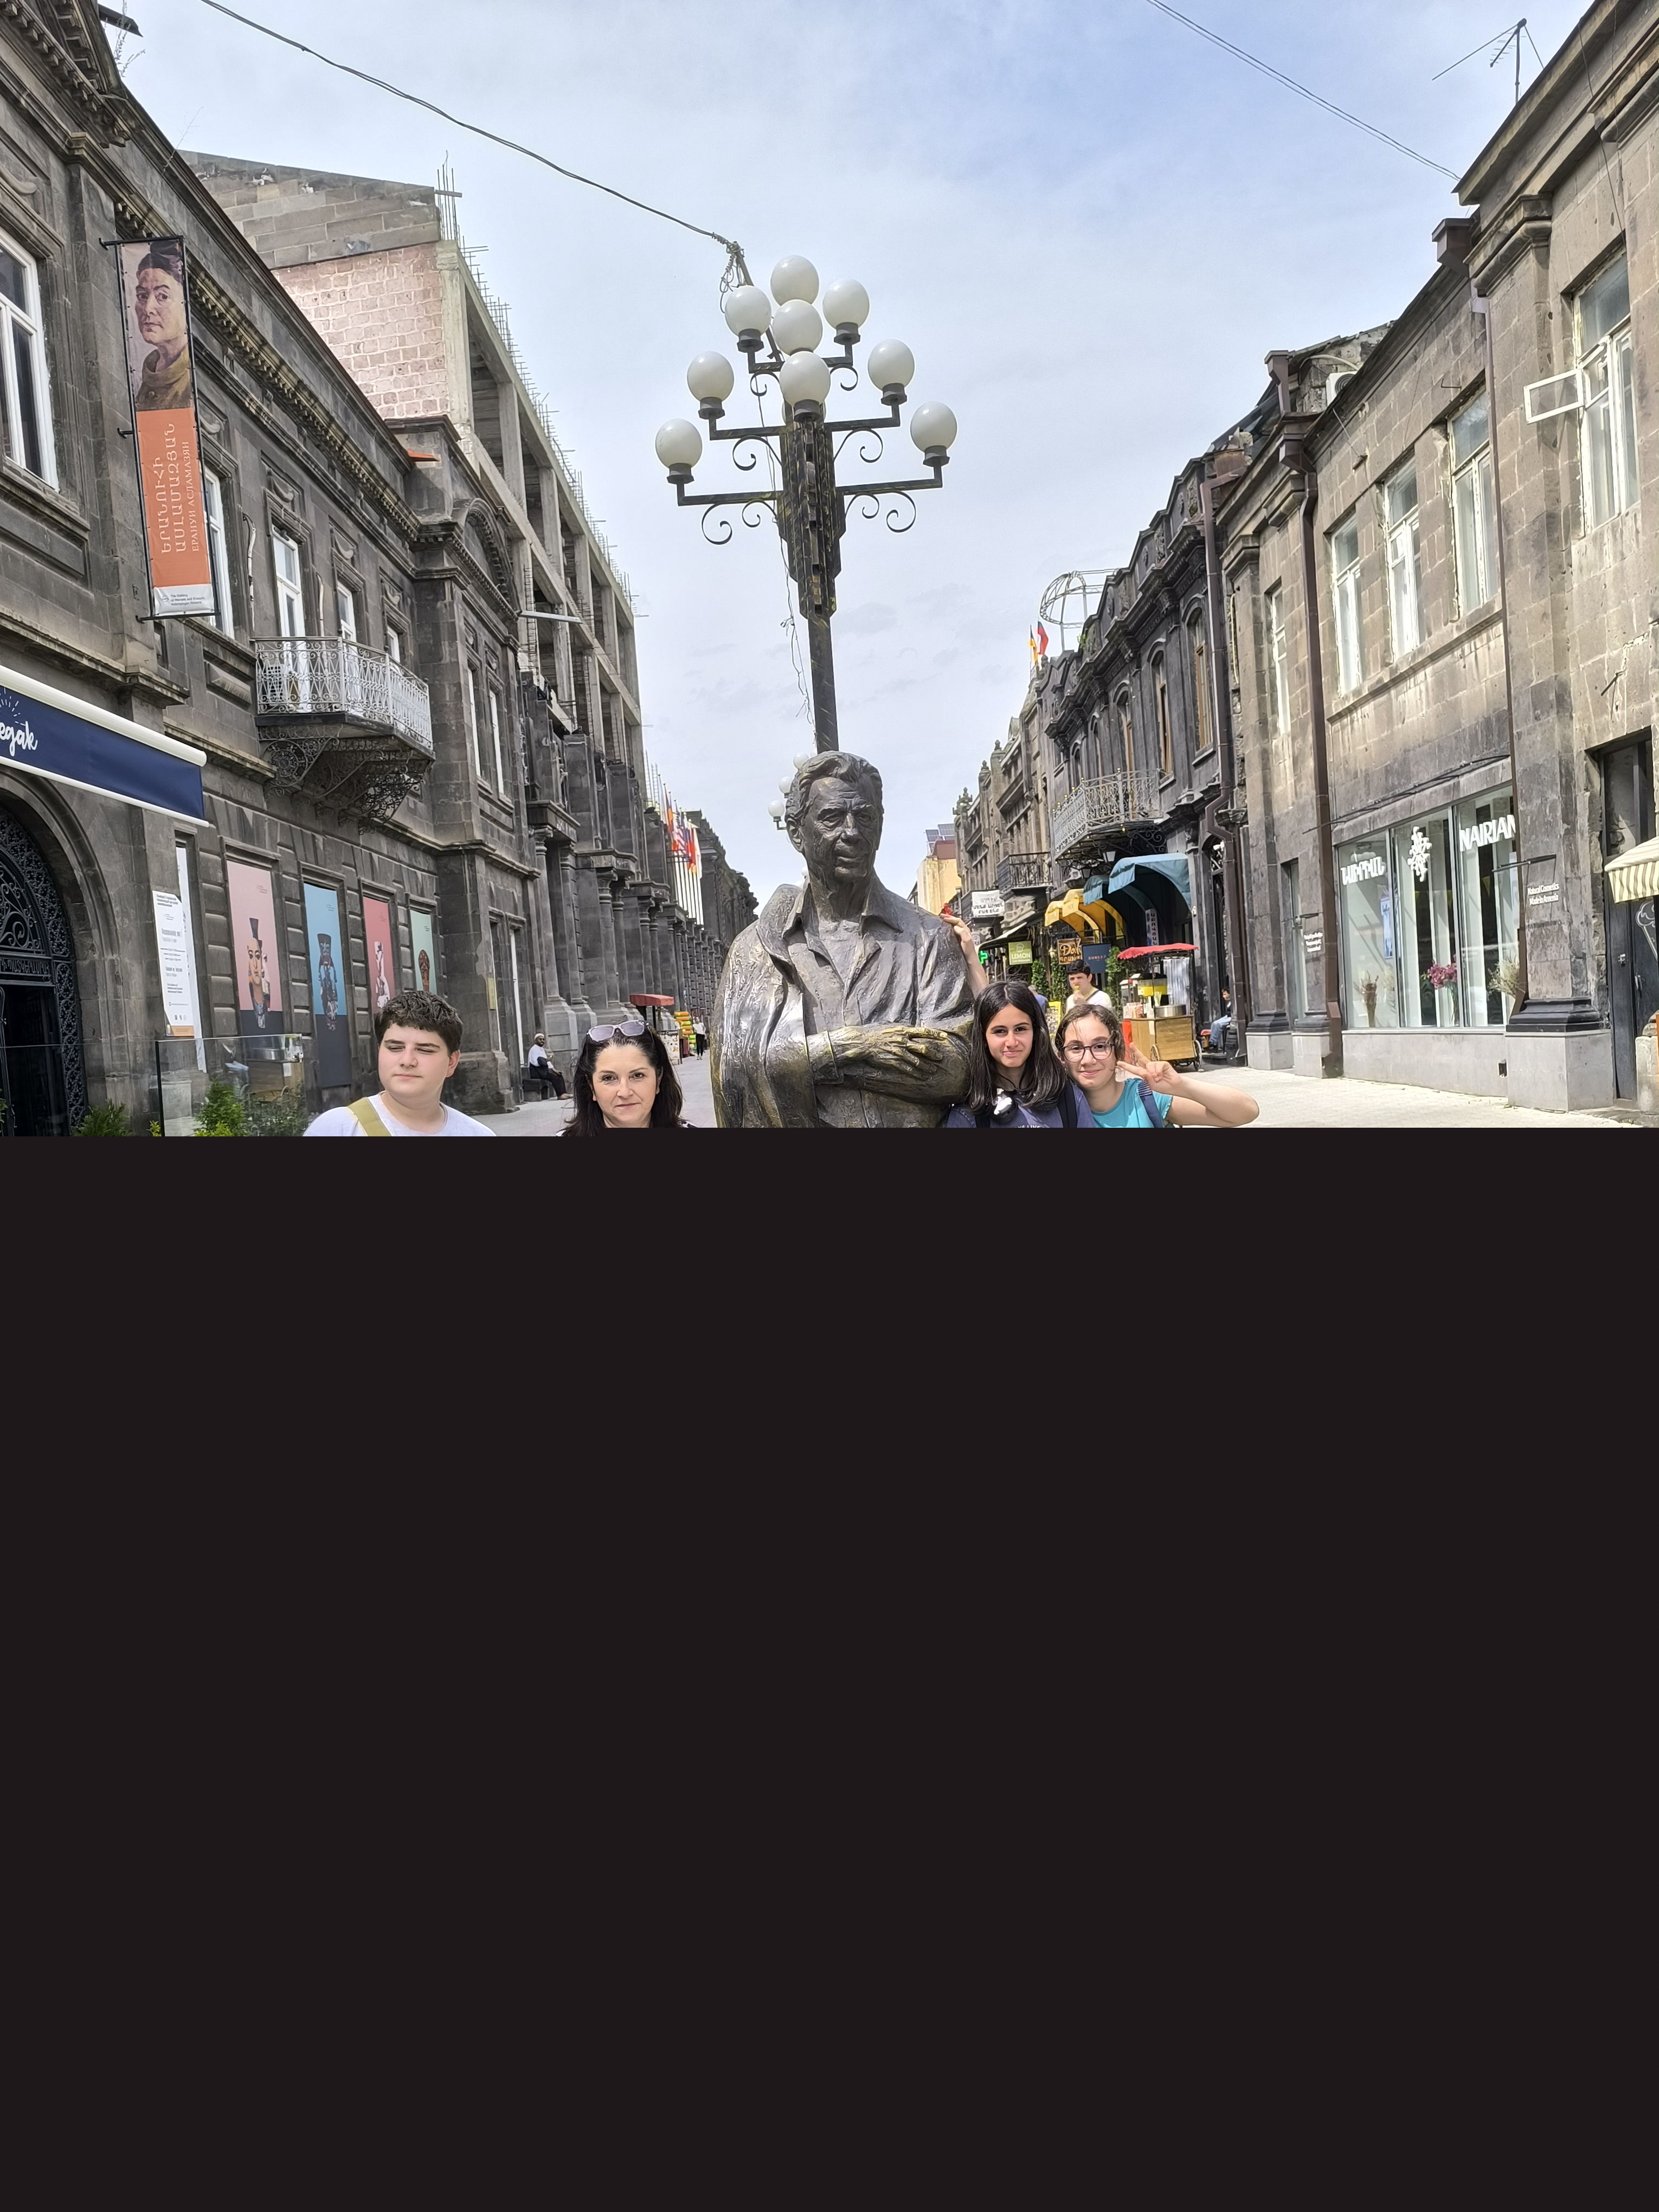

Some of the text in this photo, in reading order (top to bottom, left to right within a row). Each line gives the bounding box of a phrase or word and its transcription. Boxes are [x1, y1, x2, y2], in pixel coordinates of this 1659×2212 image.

[153, 457, 171, 554] ԵՐԱՆՈՒՀԻ
[164, 423, 186, 552] ԱՍԼԱՄԱԶՅԱՆ
[182, 442, 199, 551] ЕРАНУИ АСЛАМАЗЯН
[1459, 814, 1516, 852] NAIRIAN
